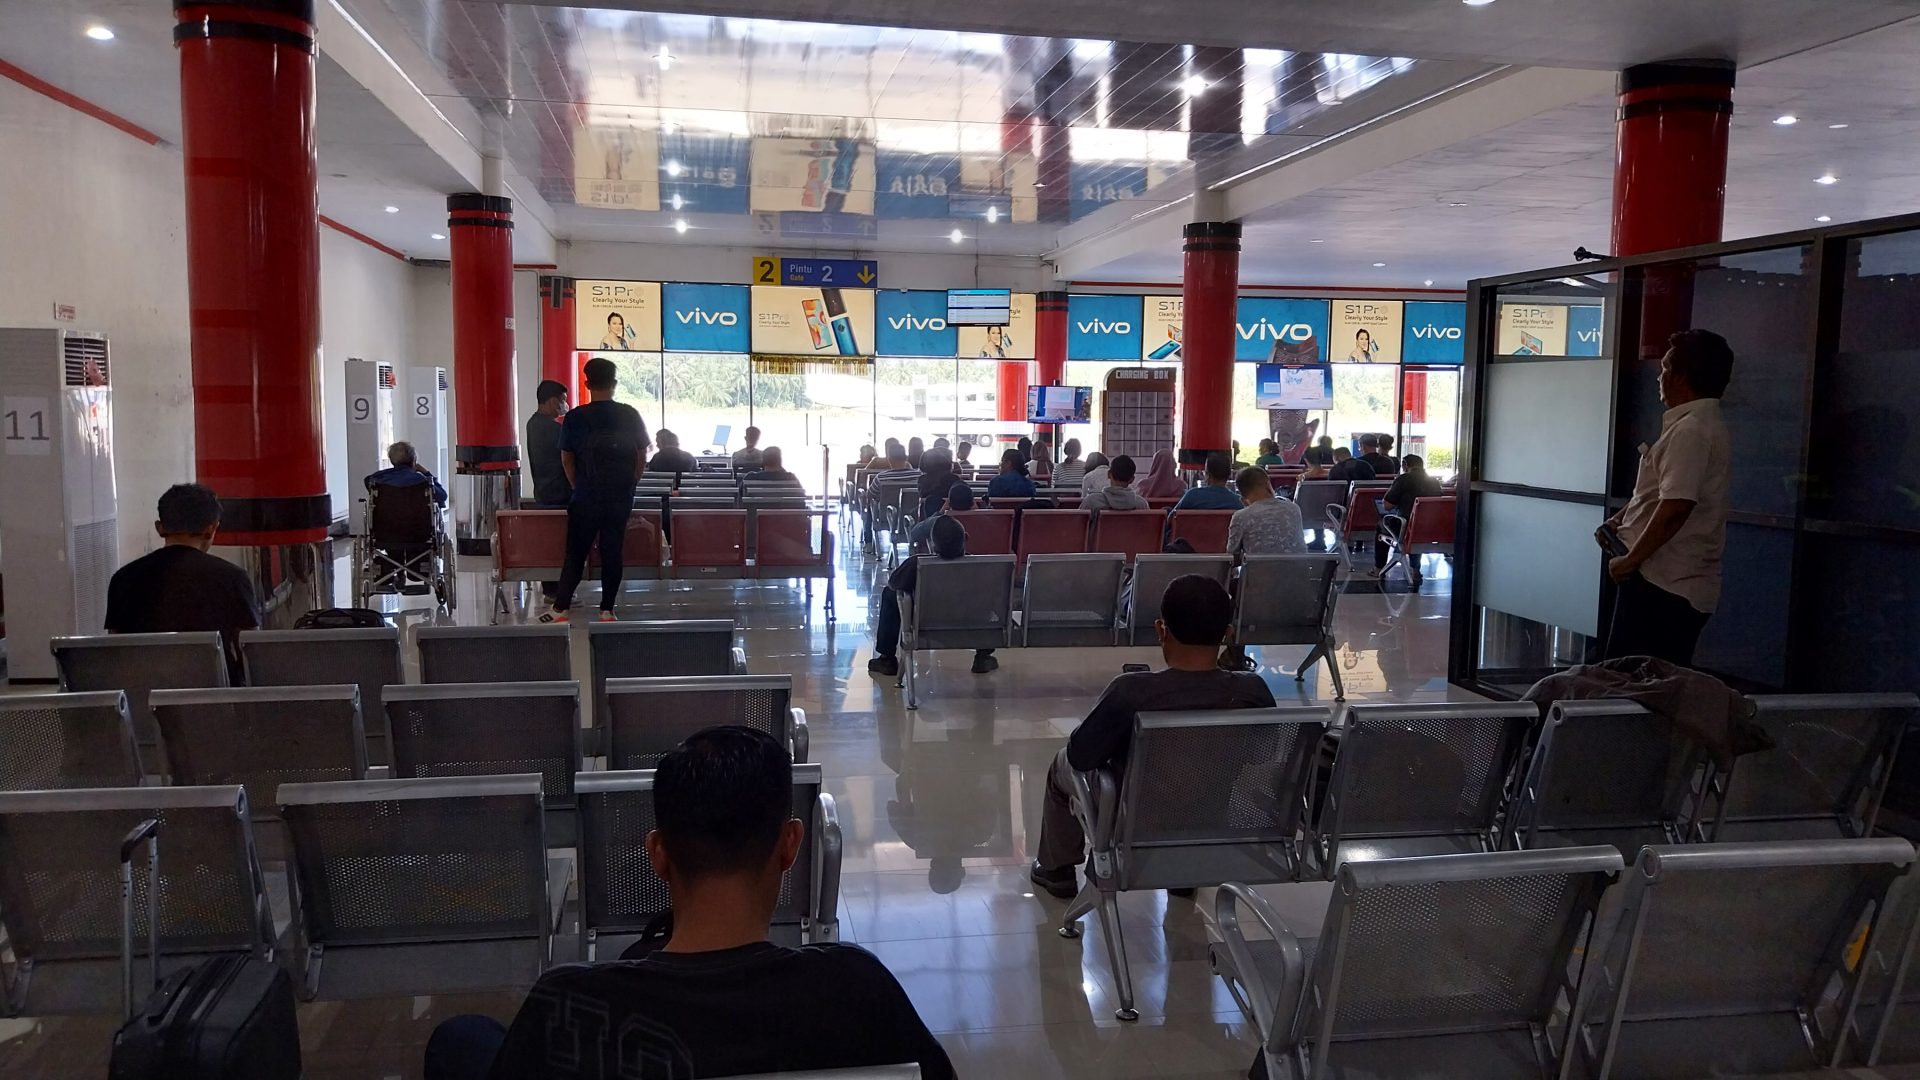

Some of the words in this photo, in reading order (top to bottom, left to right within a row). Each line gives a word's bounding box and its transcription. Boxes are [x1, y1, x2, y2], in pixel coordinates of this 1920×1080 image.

[759, 260, 775, 283] 2
[789, 264, 812, 274] Pintu
[821, 265, 833, 282] 2
[675, 307, 738, 326] vivo
[888, 313, 947, 331] vivo
[1077, 318, 1131, 334] vivo
[1236, 317, 1313, 341] vivo
[1412, 323, 1461, 339] vivo
[1115, 369, 1149, 380] CHARGING
[1153, 370, 1169, 380] BOX
[354, 398, 370, 420] 9
[416, 396, 430, 416] 8
[5, 410, 50, 441] 11
